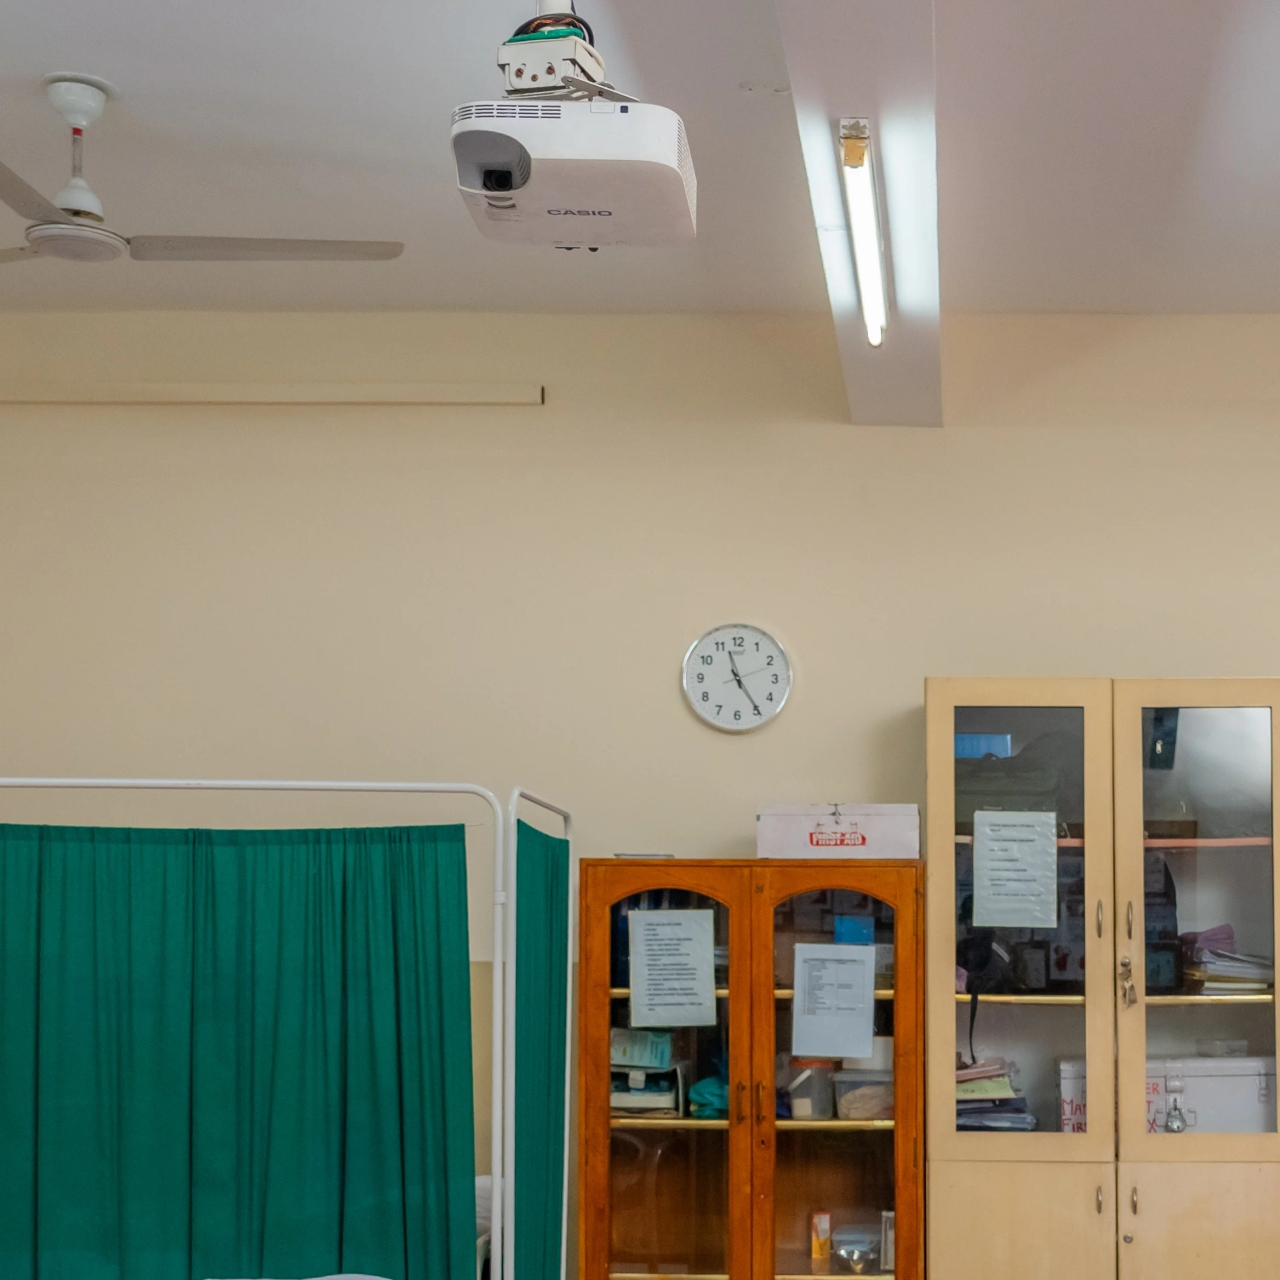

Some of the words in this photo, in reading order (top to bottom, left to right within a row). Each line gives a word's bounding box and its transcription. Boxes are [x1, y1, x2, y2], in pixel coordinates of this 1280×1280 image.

[547, 209, 613, 217] CASIO
[714, 641, 726, 652] 11
[731, 636, 745, 648] 12
[754, 641, 760, 652] 1
[700, 655, 714, 666] 10
[766, 655, 774, 666] 2
[696, 673, 705, 683] 9
[771, 673, 779, 684] 3
[701, 691, 709, 702] 8
[766, 692, 774, 703] 4
[715, 705, 723, 715] 7
[733, 710, 742, 721] 6
[752, 705, 761, 716] 5
